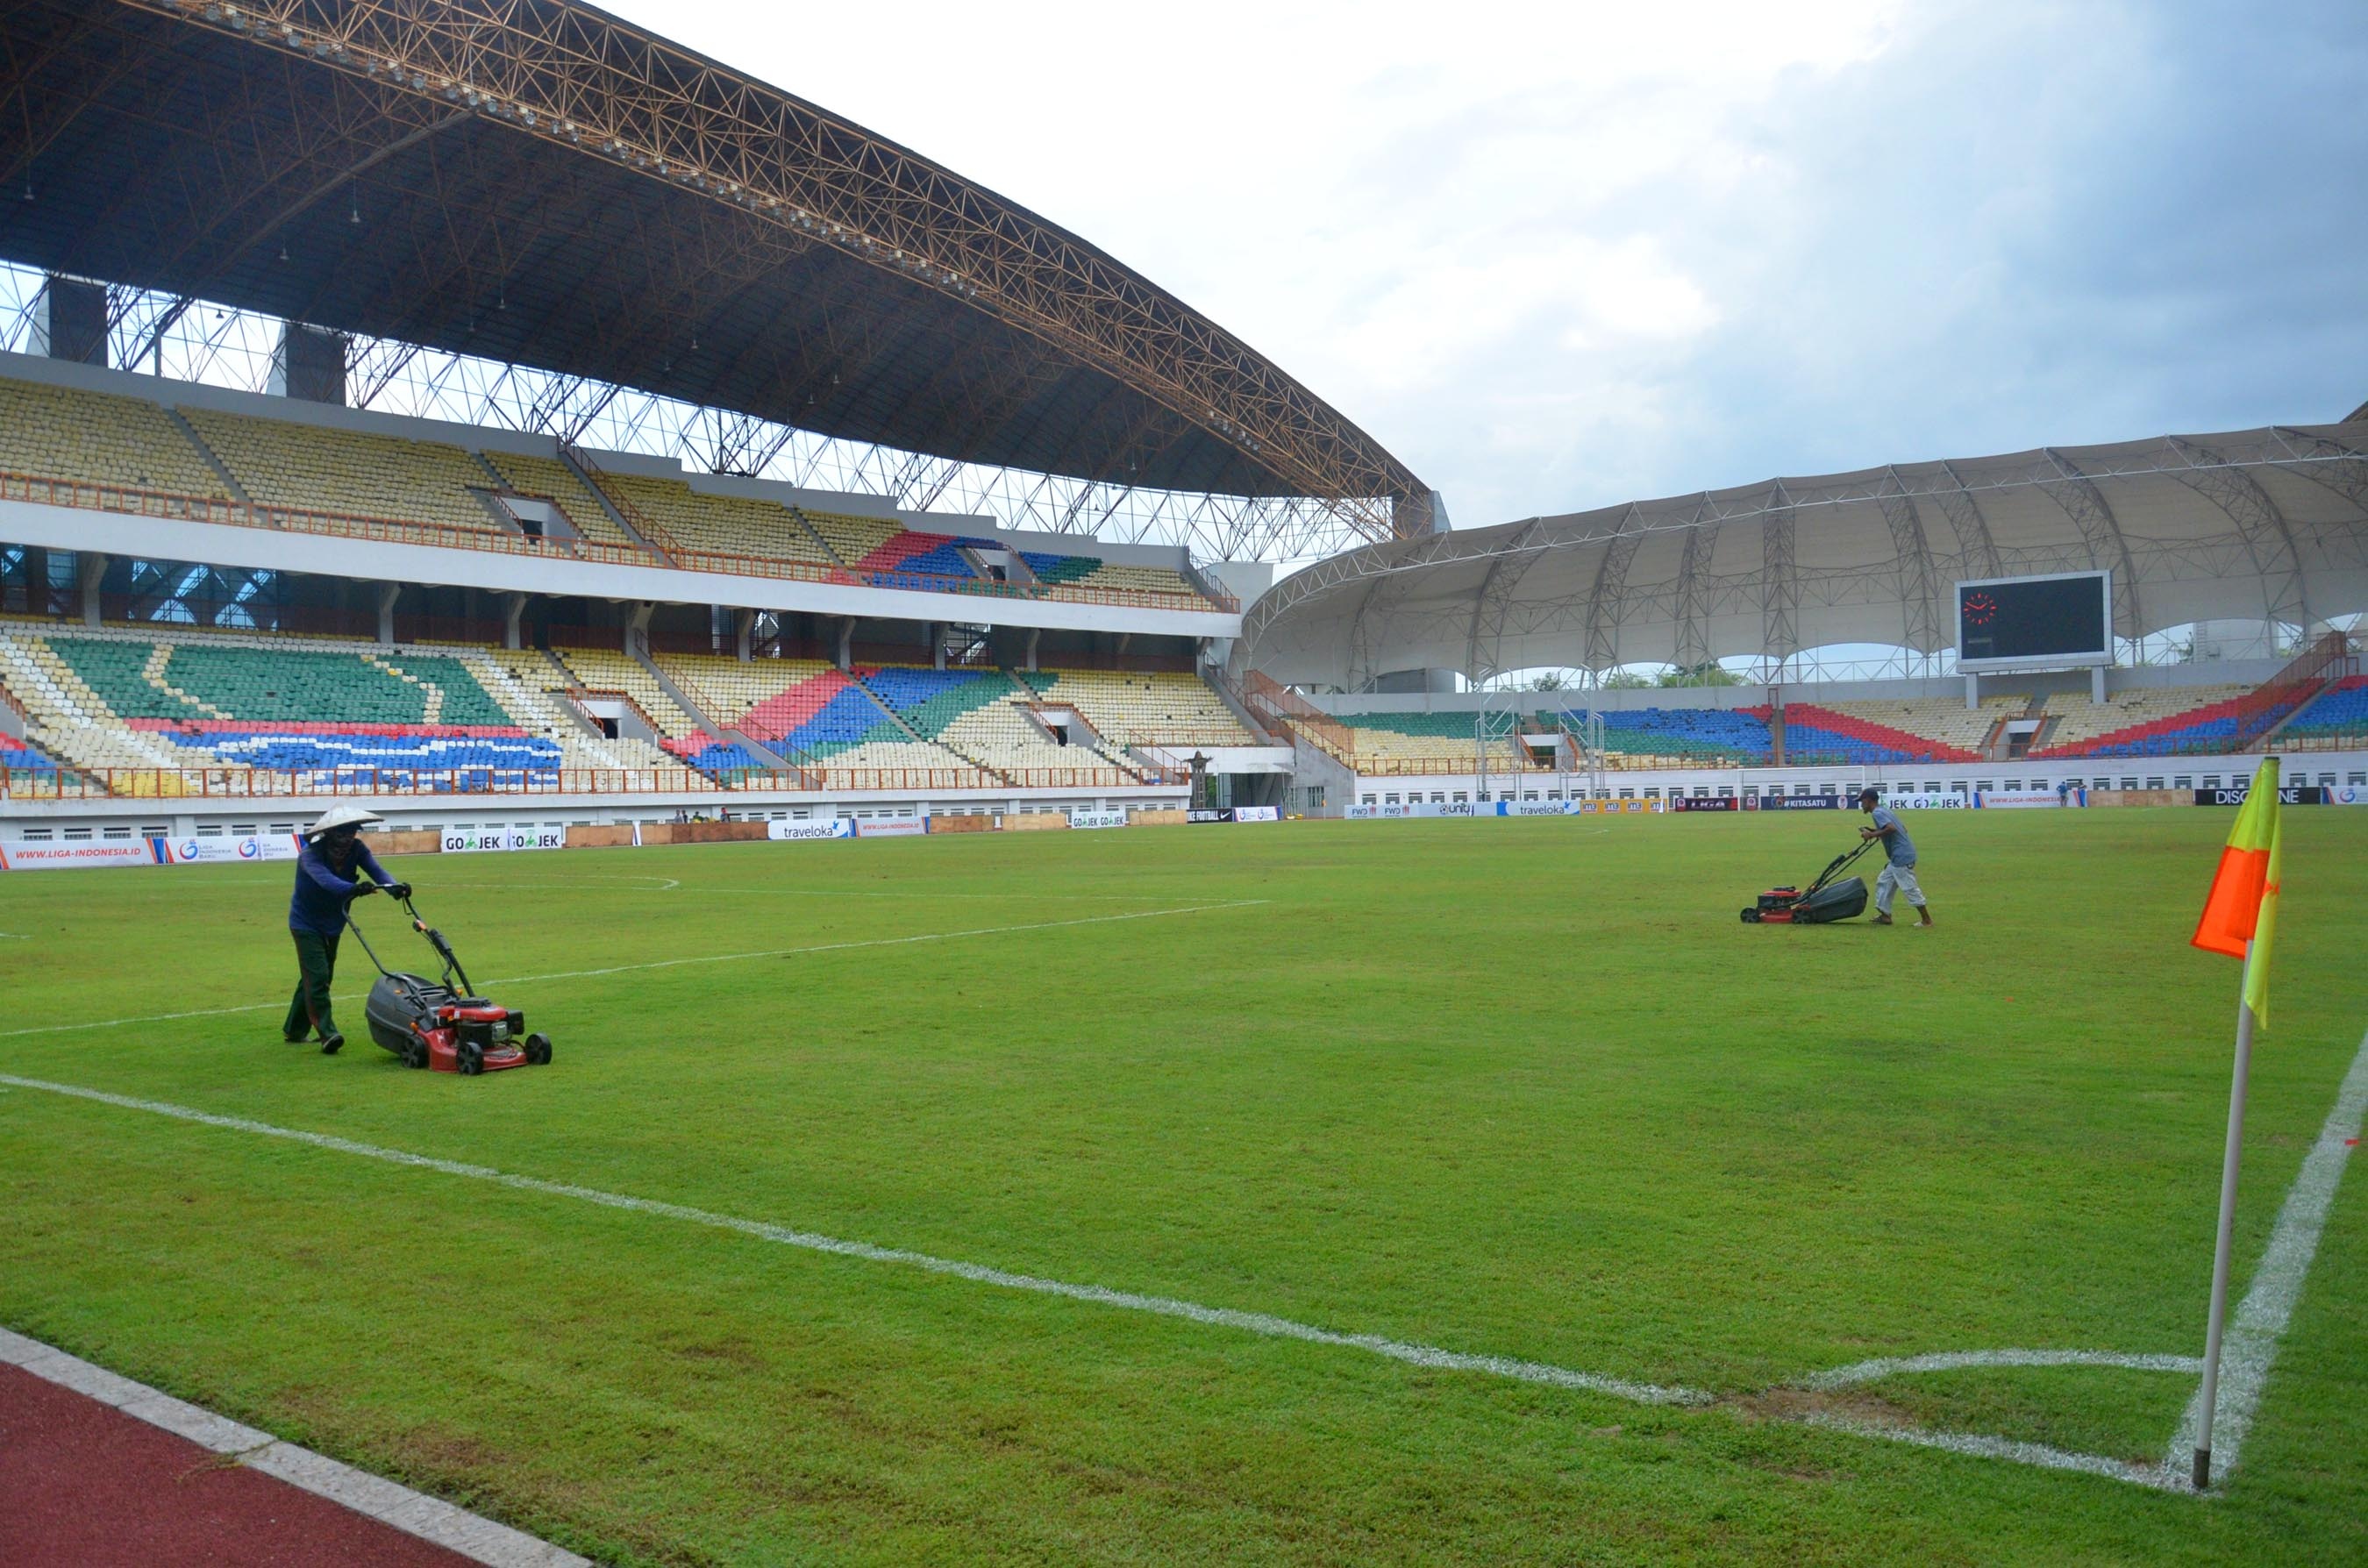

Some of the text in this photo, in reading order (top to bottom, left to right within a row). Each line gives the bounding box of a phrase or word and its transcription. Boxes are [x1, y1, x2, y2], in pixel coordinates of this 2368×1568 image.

[1784, 799, 1827, 808] #KITASATU
[1890, 800, 1908, 809] JEK
[1942, 799, 1961, 808] JEK
[1520, 805, 1565, 815] traveloka
[1114, 816, 1123, 825] JEK
[1196, 810, 1220, 821] FOOTBALL
[1088, 817, 1098, 826] JEK
[784, 825, 833, 837] traveloka
[446, 837, 500, 850] GO JEK
[539, 835, 559, 847] JEK
[16, 848, 141, 859] WWW.LIGA-INDONESIA.ID
